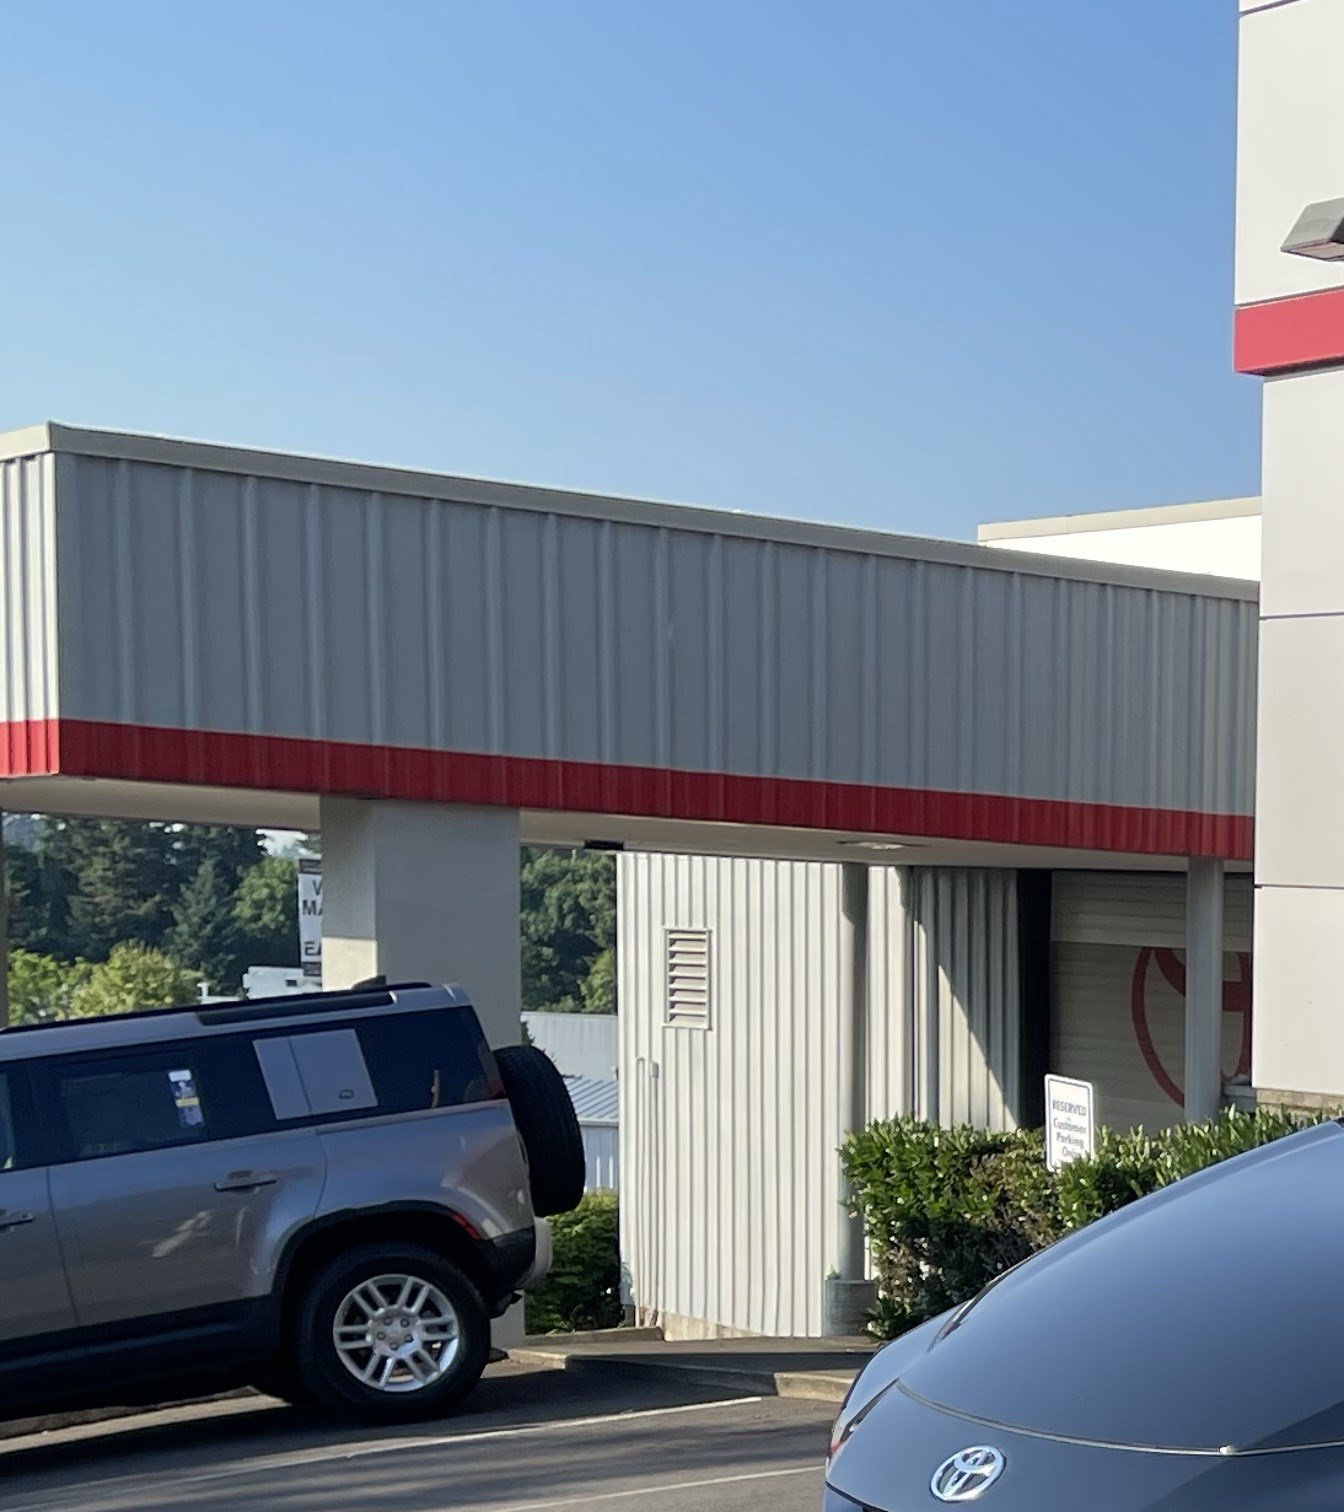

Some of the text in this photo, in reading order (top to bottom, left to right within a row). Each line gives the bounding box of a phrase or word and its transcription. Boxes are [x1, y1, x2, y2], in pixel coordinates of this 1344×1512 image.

[1052, 1099, 1087, 1116] RESERVED
[1053, 1117, 1087, 1134] Customer
[1056, 1131, 1084, 1149] Parking
